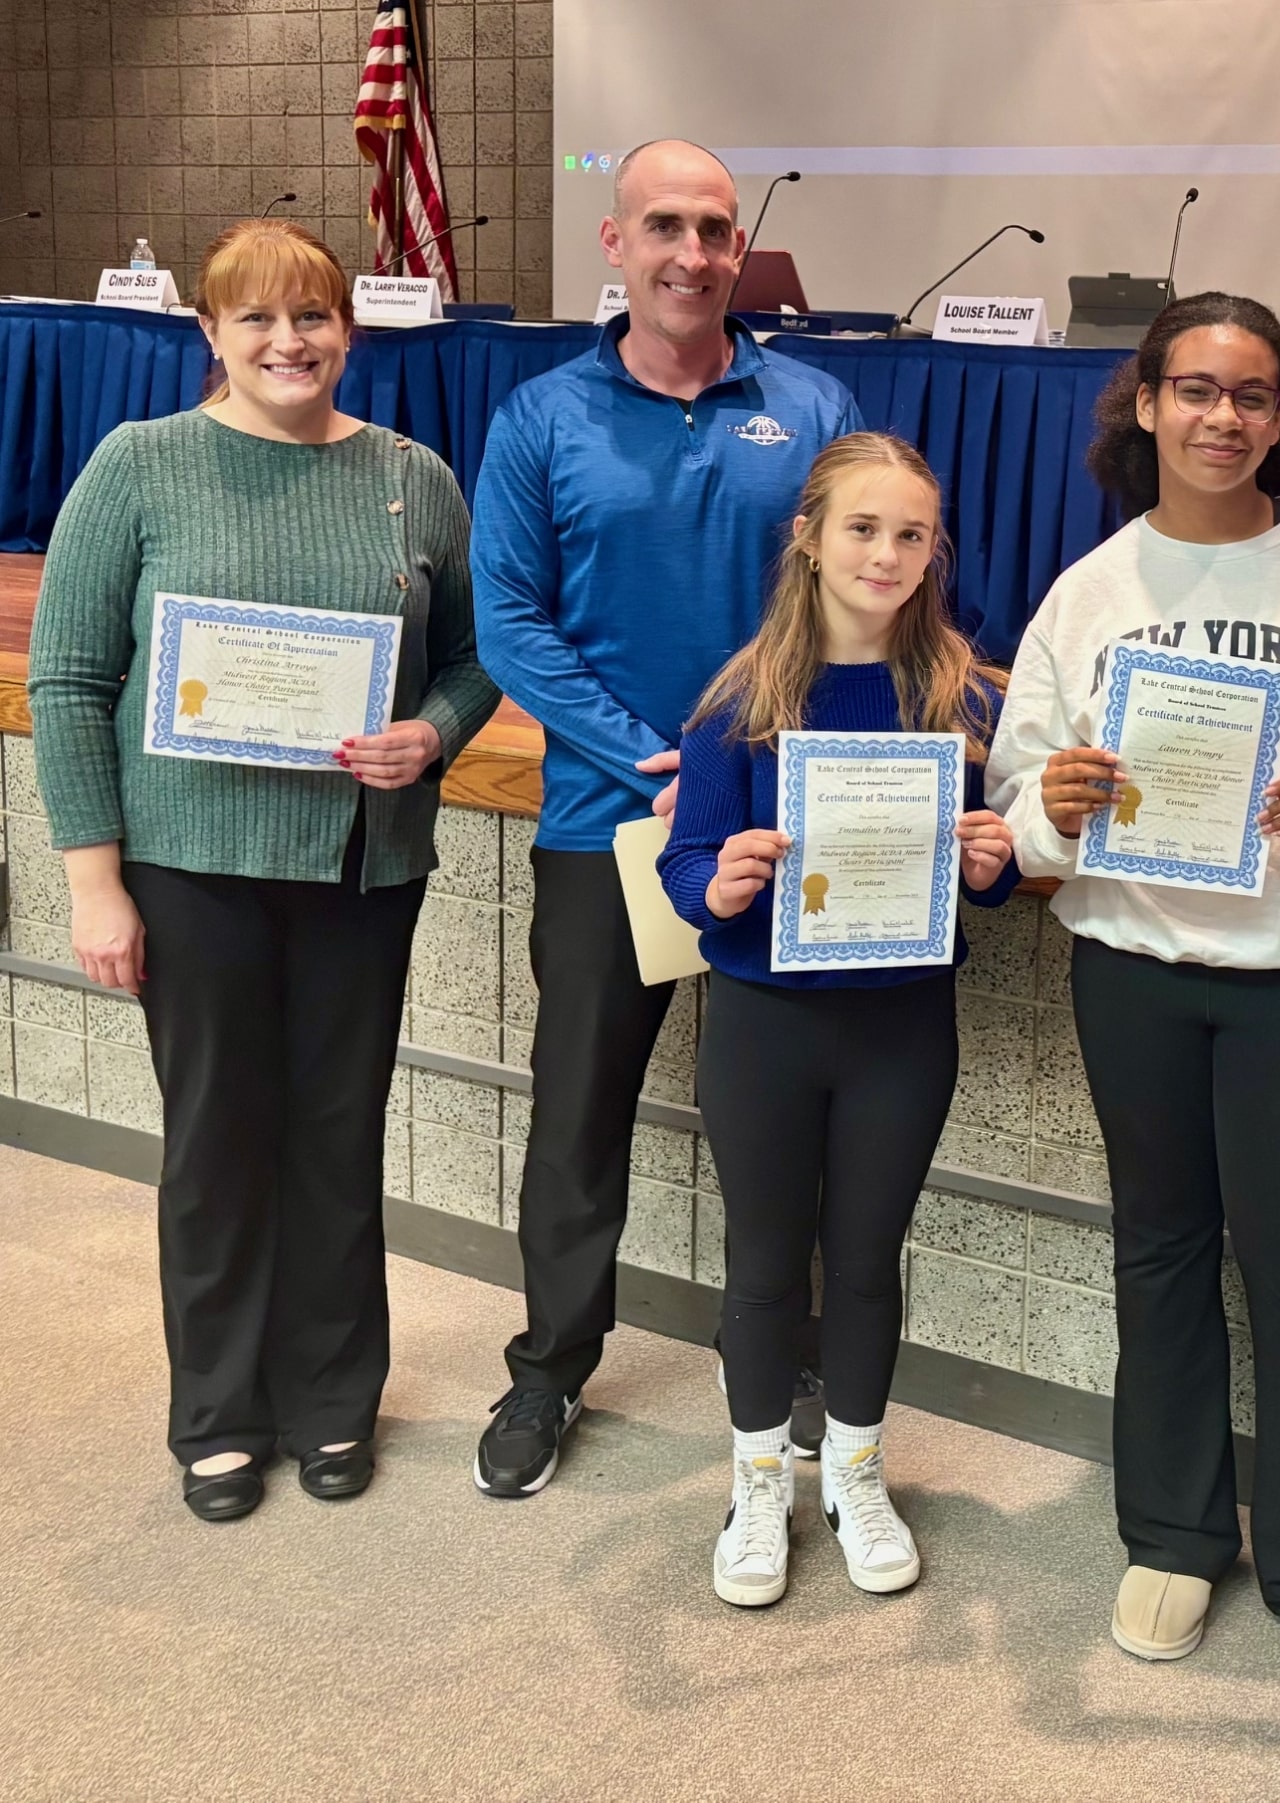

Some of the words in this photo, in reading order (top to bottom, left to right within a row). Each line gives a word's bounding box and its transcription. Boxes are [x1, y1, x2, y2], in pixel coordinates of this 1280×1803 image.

[109, 274, 135, 286] CINDY
[135, 274, 157, 286] SUES
[360, 281, 372, 290] DR.
[375, 281, 396, 291] LARRY
[397, 283, 427, 293] VERACCO
[607, 290, 620, 299] DR.
[366, 297, 416, 306] Superintendent
[944, 303, 985, 319] LOUISE
[987, 304, 1034, 320] TALLENT
[224, 625, 260, 634] Central
[266, 629, 298, 639] School
[304, 634, 361, 645] Corporation
[218, 637, 264, 649] Certificate
[267, 641, 280, 650] Of
[283, 643, 338, 657] Appreciation
[236, 656, 279, 667] Christina
[223, 671, 256, 680] Midwest
[259, 674, 286, 685] Region
[216, 679, 243, 687] Honor
[272, 685, 319, 697] Participant
[1141, 678, 1158, 687] Lake
[1161, 681, 1187, 692] Central
[1189, 686, 1213, 696] School
[1216, 690, 1258, 703] Corporation
[1137, 706, 1182, 722] Certificate
[1186, 715, 1194, 723] of
[1196, 716, 1253, 732] Achievement
[1158, 744, 1190, 755] Lauren
[891, 766, 931, 774] Corporation
[1130, 764, 1162, 773] Midwest
[1165, 769, 1190, 778] Region
[1177, 779, 1221, 789] Participant
[817, 793, 863, 802] Certificate
[866, 794, 873, 802] of
[876, 794, 930, 803] Achievement
[1166, 798, 1198, 809] Certificate
